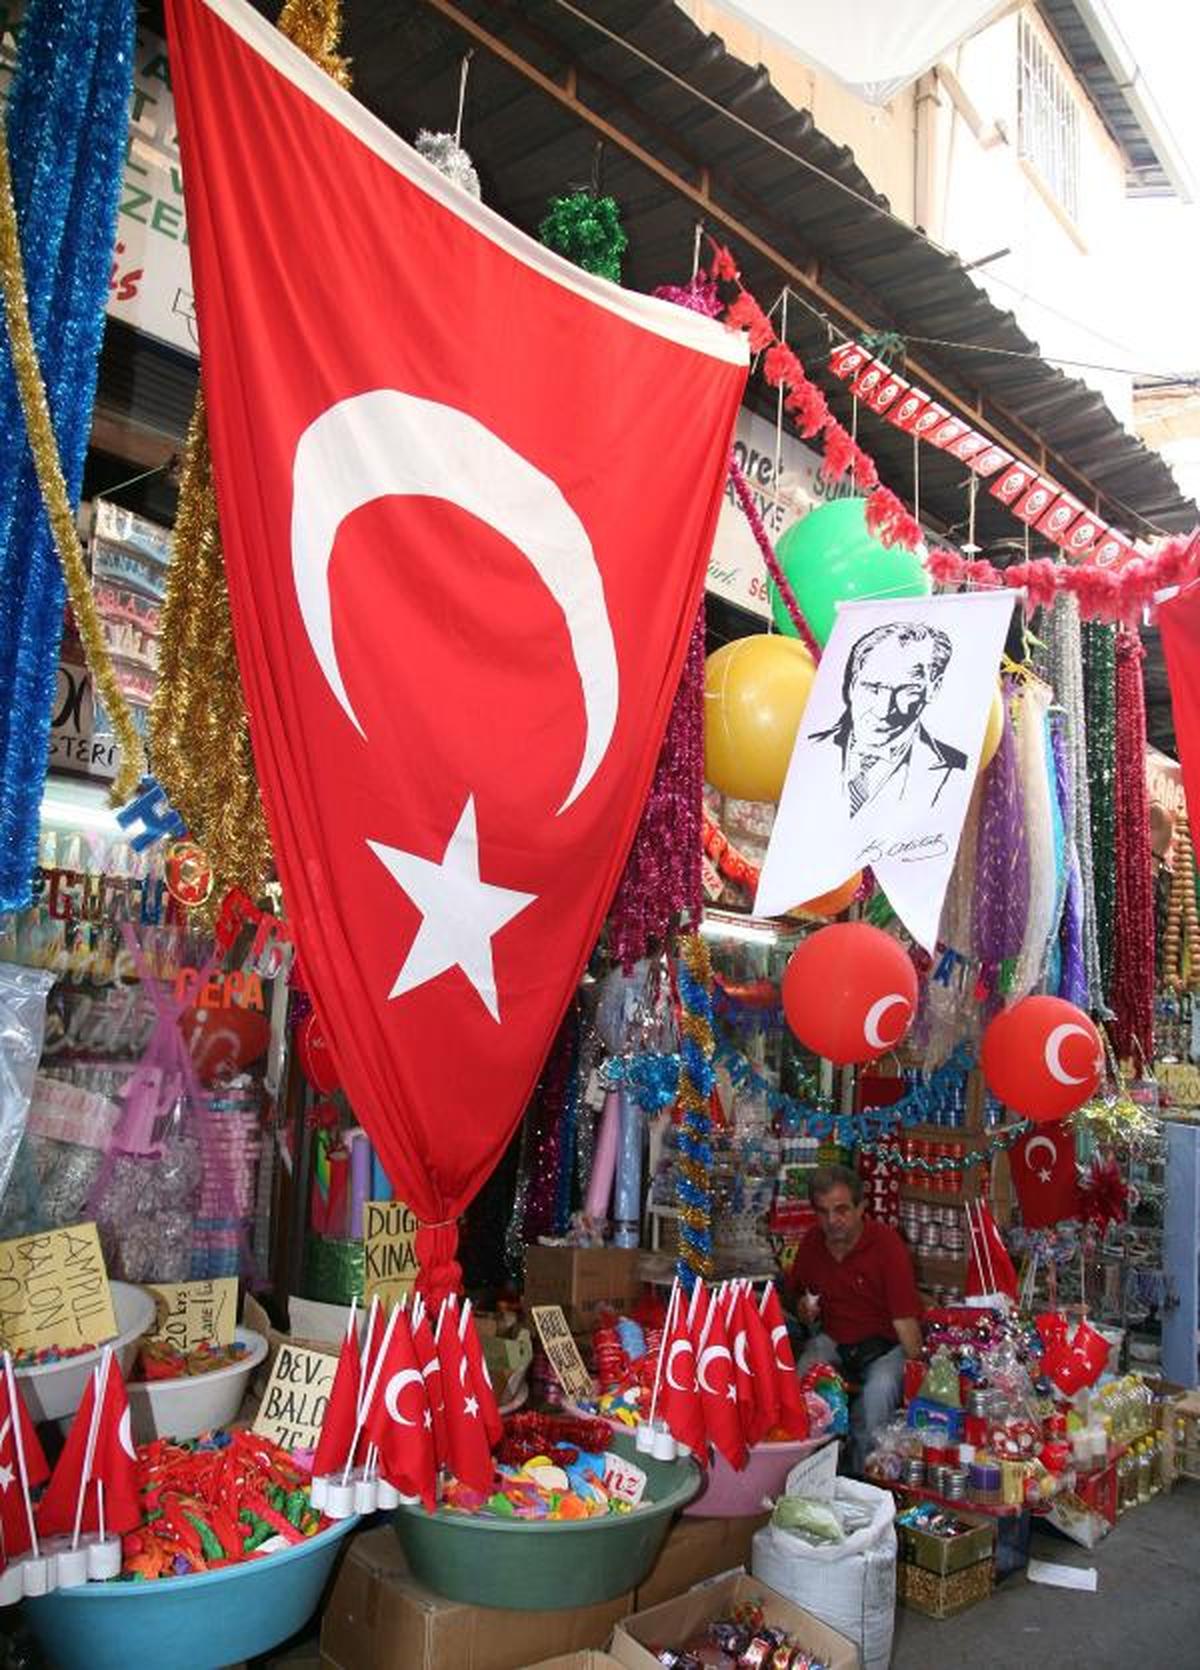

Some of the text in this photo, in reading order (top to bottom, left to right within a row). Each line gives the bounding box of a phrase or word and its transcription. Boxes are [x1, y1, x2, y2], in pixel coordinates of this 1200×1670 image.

[16, 1235, 69, 1332] BALON
[58, 1231, 107, 1336] AMPUL
[365, 1239, 420, 1278] KINA
